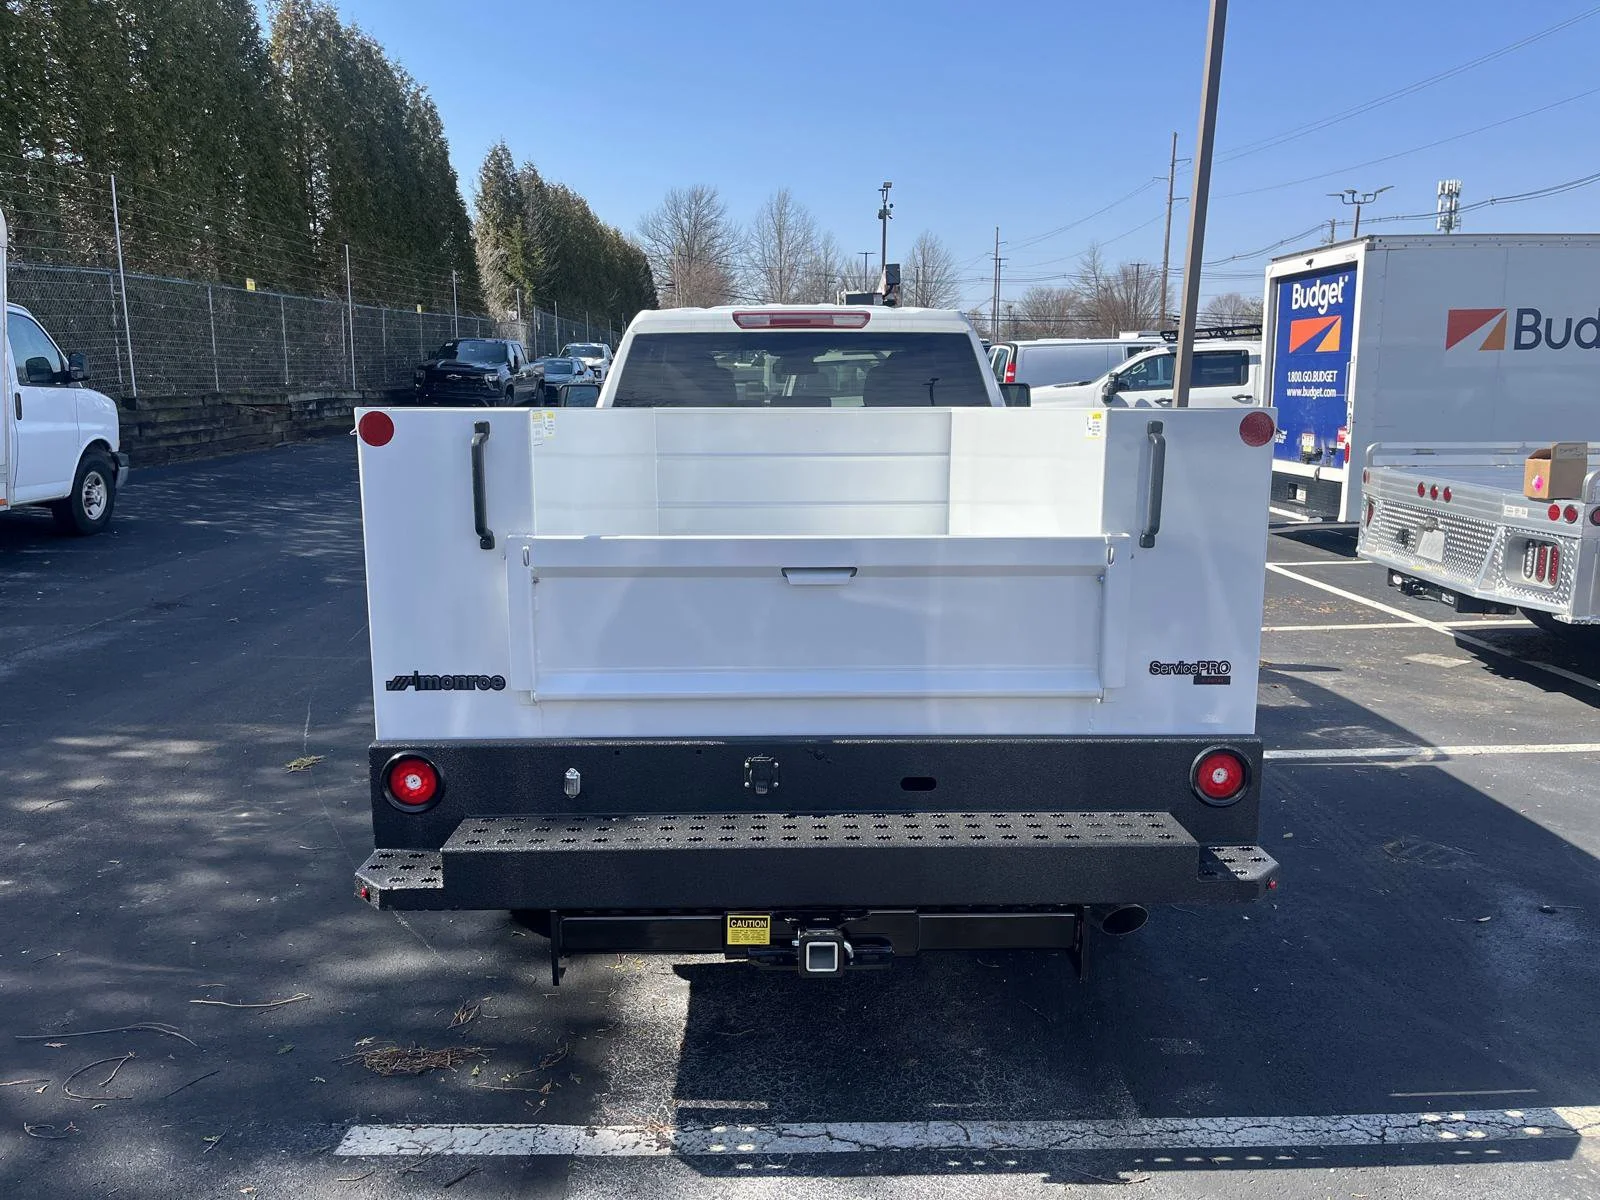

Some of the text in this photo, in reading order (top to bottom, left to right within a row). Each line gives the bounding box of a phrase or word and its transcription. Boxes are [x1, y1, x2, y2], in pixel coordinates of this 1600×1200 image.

[1291, 276, 1344, 315] Budget
[1514, 308, 1600, 350] Bud
[1286, 385, 1337, 400] www.budget.com
[1149, 660, 1232, 676] ServicePRO
[414, 672, 506, 691] monroe
[730, 919, 767, 928] CAUTION
